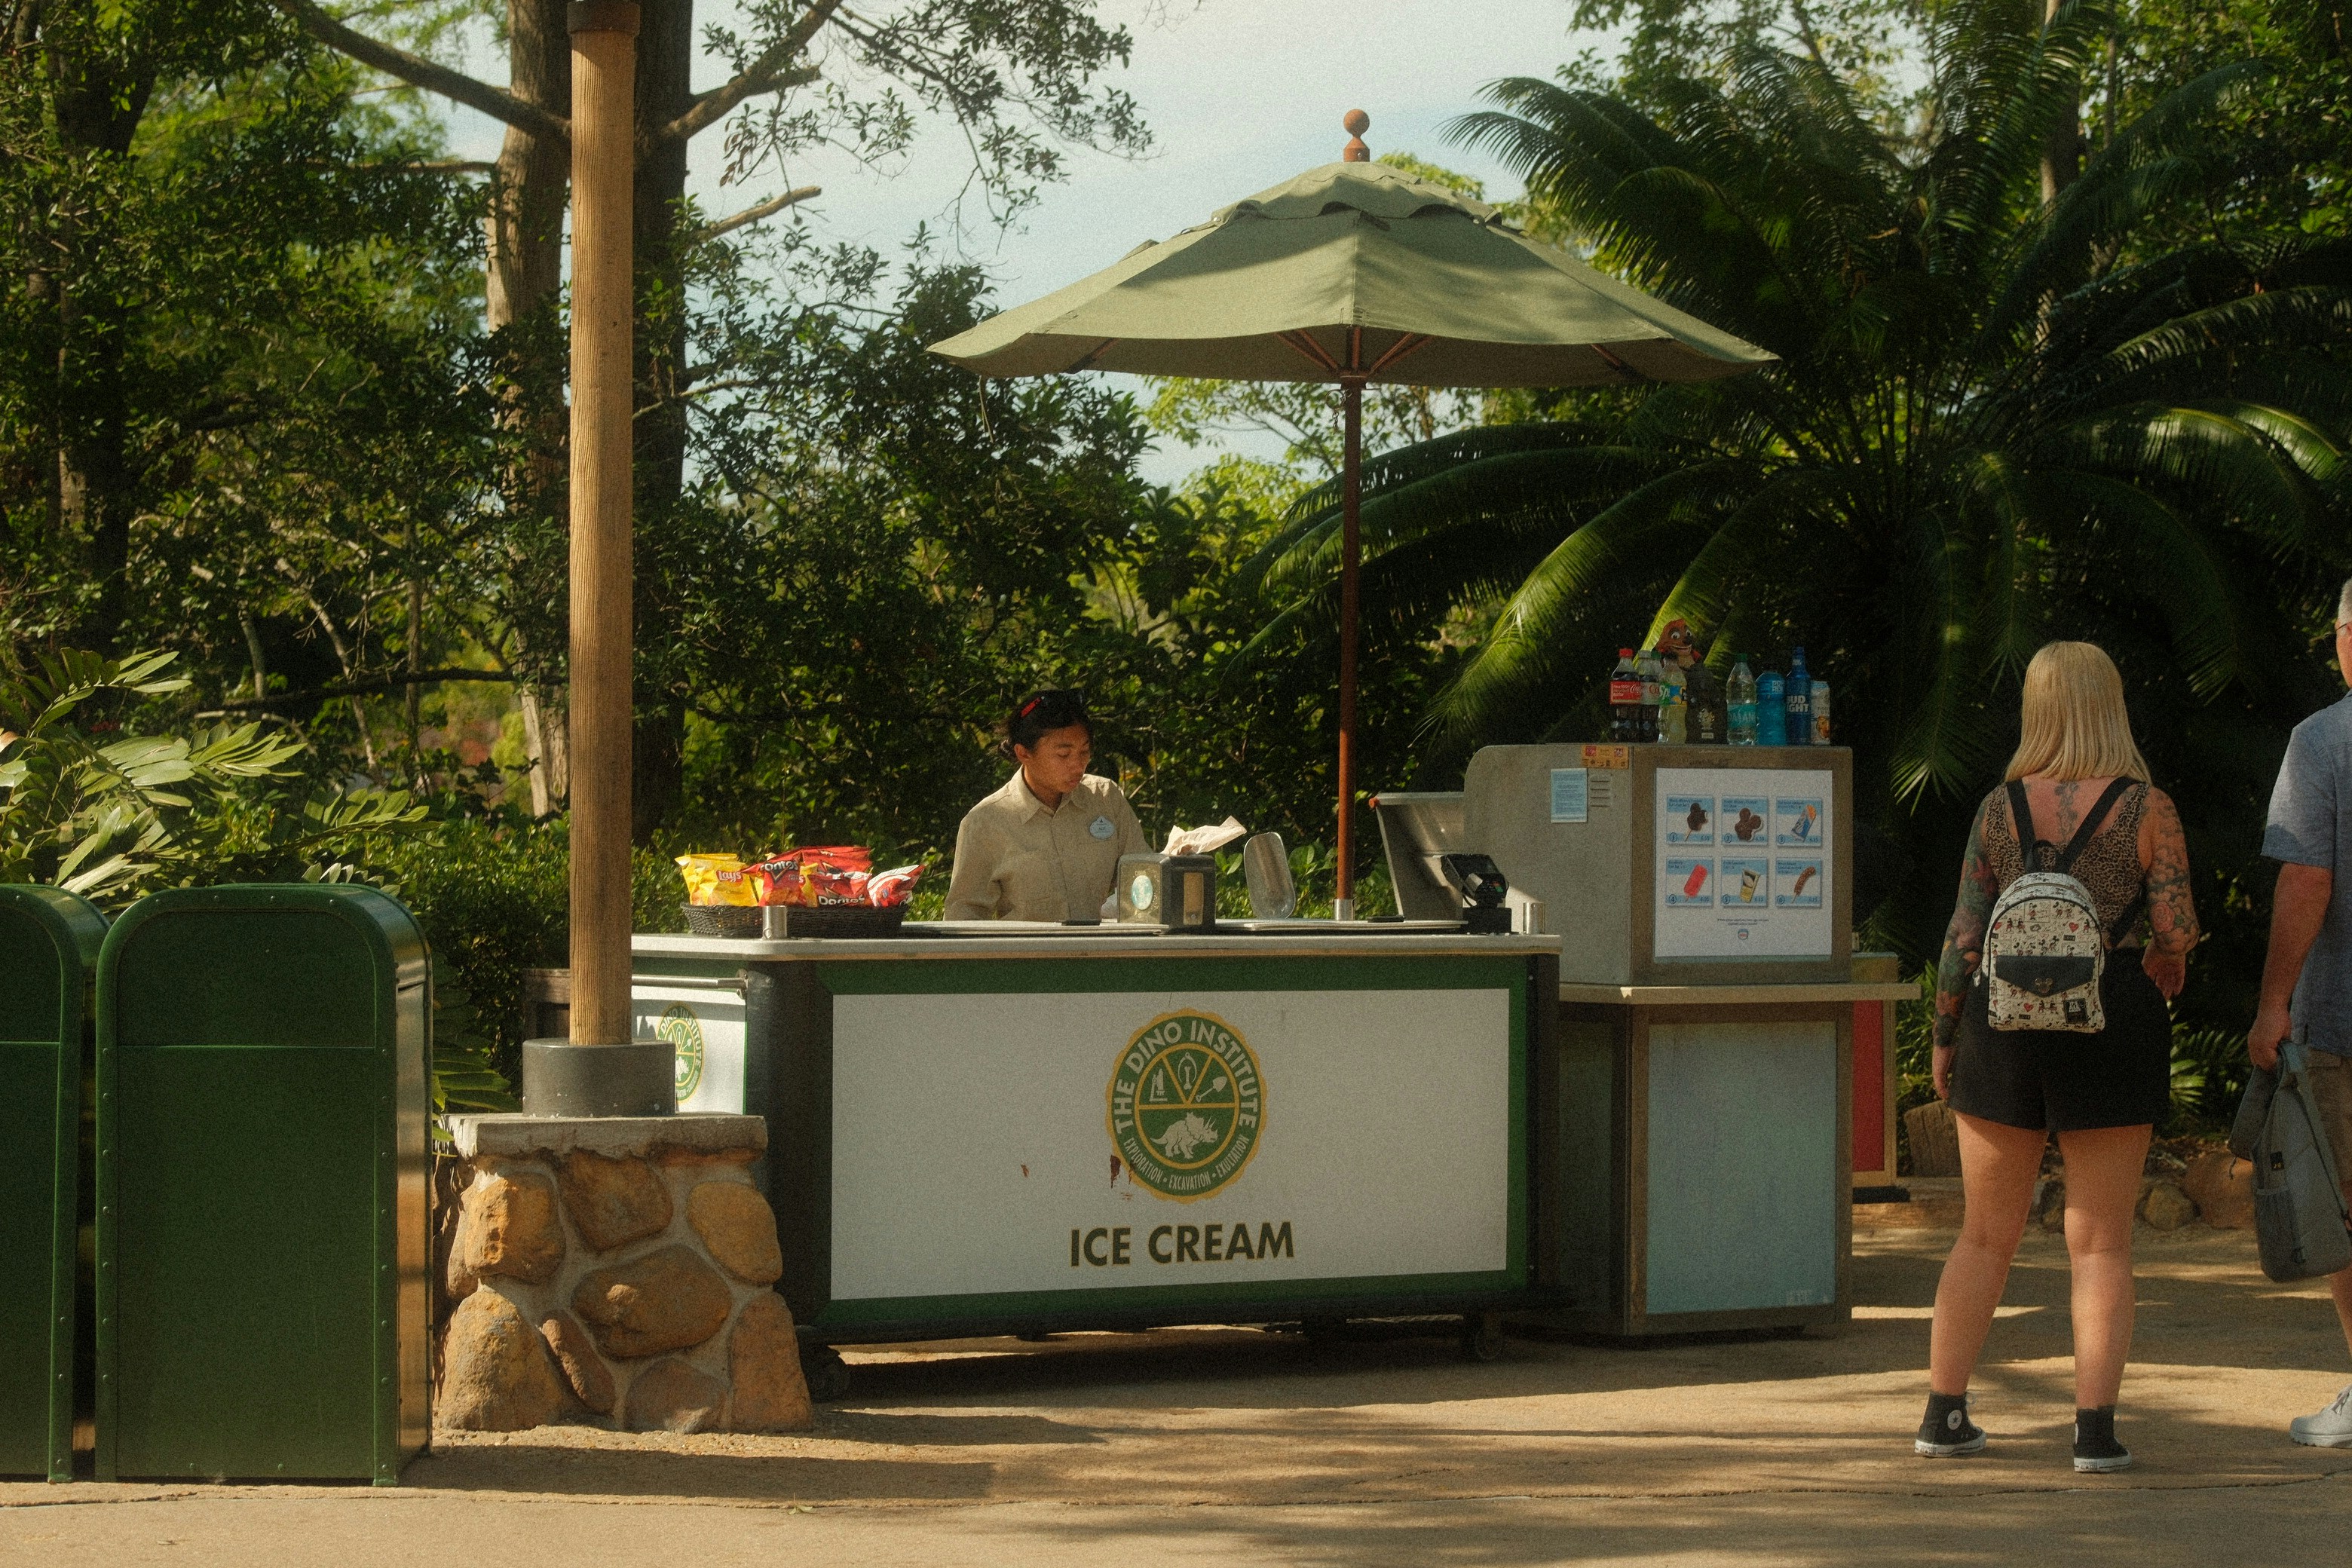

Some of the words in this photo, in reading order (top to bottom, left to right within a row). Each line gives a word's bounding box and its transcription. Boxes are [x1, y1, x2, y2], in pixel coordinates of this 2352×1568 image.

[818, 894, 865, 905] Doritos
[660, 1007, 678, 1033] DINO
[680, 1007, 702, 1067] INSTITUTE
[1114, 1078, 1135, 1134] THE
[1125, 1021, 1182, 1075] DINO
[1190, 1020, 1258, 1129] INSTITUTE
[1123, 1137, 1163, 1184] EXPLORATION
[1168, 1172, 1211, 1190] EXCAVATION
[1216, 1135, 1250, 1178] EXULTATION
[1070, 1227, 1131, 1267] ICE
[1148, 1220, 1295, 1263] CREAM
